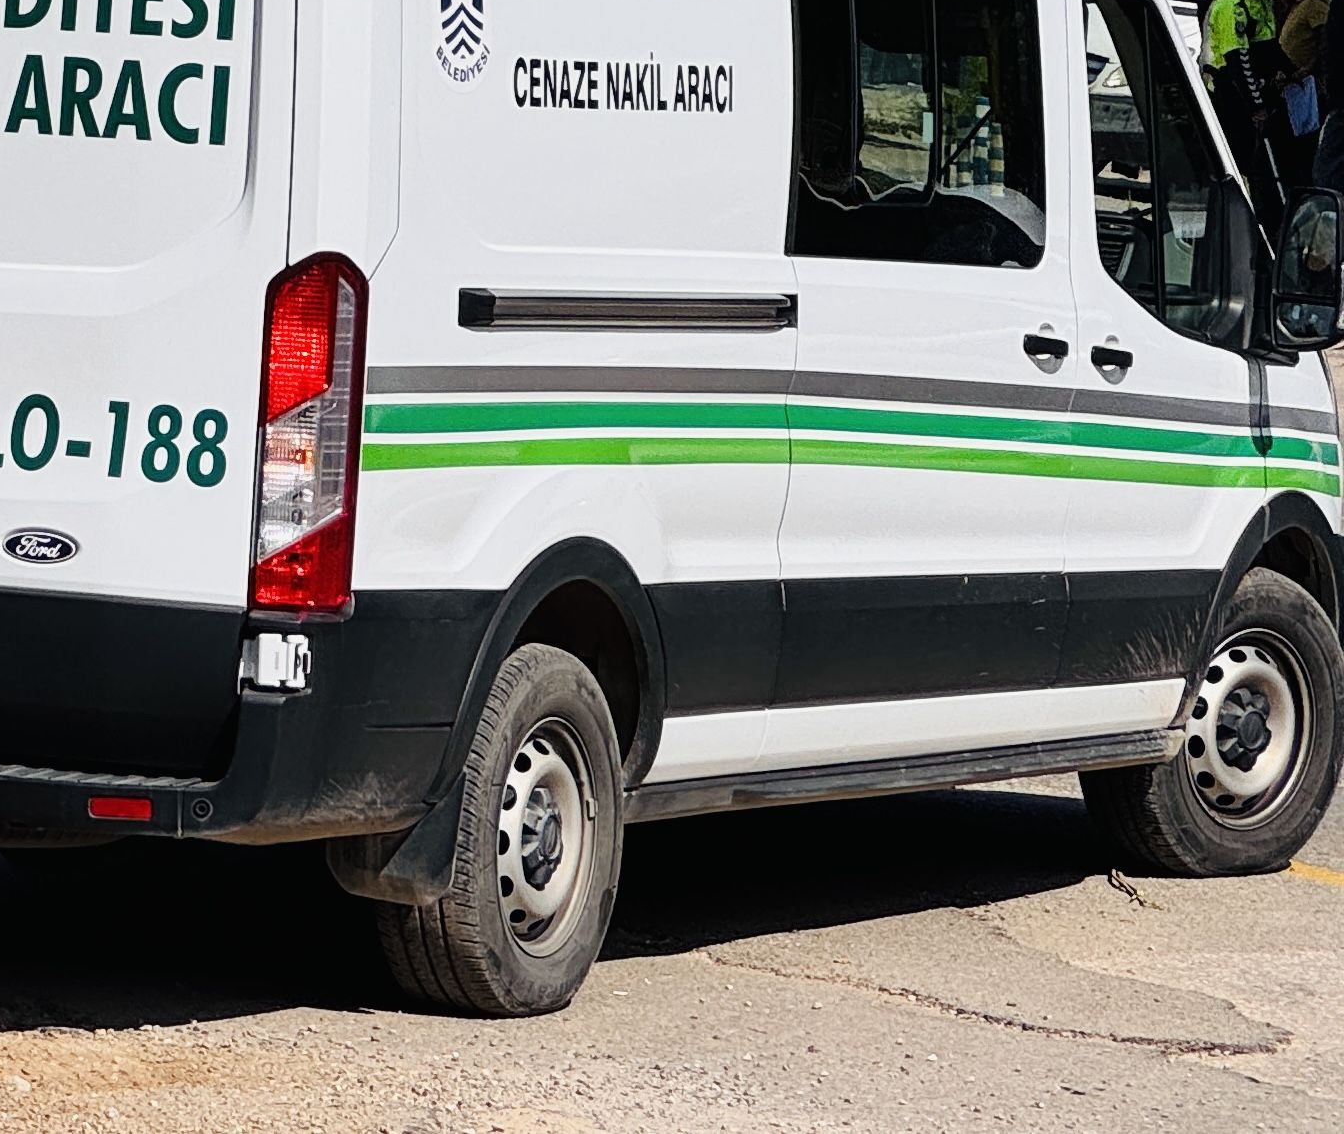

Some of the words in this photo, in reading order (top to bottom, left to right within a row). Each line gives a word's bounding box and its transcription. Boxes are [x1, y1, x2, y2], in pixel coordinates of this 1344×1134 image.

[435, 42, 491, 83] BELEDİYESİ
[513, 56, 599, 109] CENAZE
[606, 52, 668, 112] NAKİL
[673, 64, 734, 114] ARACI
[4, 53, 230, 147] ARACI
[15, 534, 63, 559] Ford
